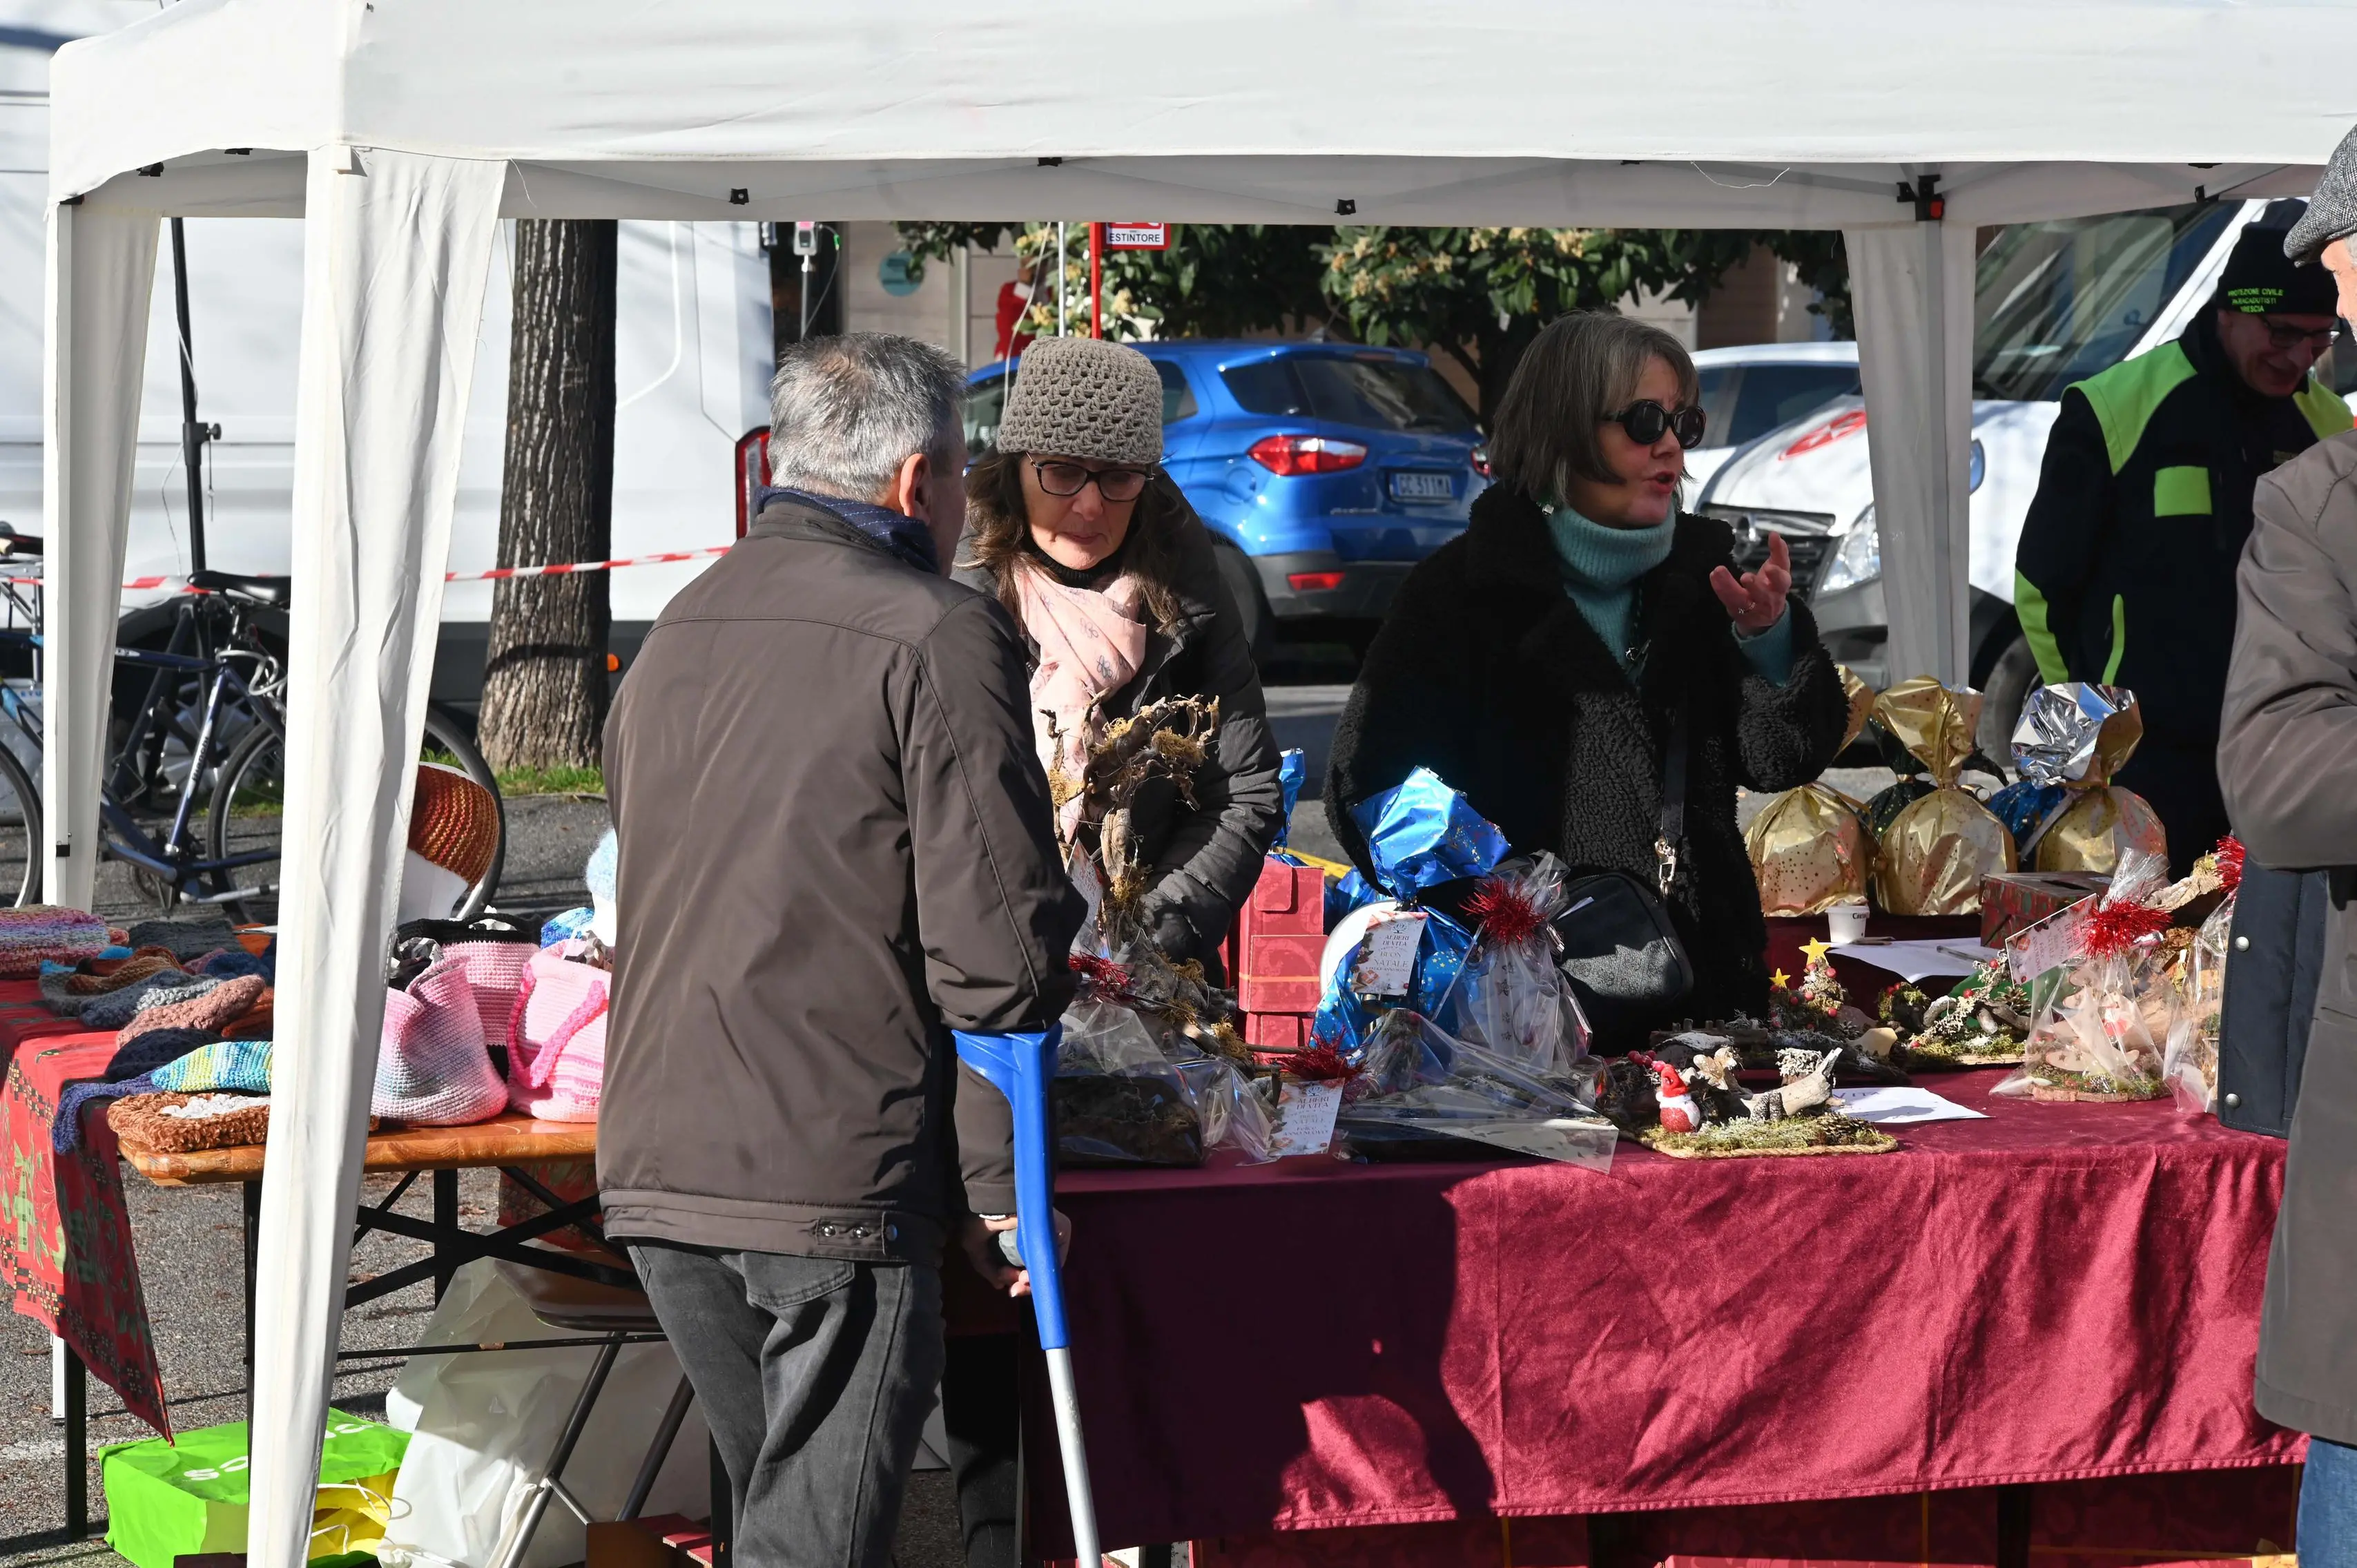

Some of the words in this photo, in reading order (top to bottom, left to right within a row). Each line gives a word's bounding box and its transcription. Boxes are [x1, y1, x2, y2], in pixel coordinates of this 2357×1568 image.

[1109, 233, 1161, 242] ESTINTORE
[2262, 288, 2284, 296] CIVILE
[1374, 958, 1409, 967] NATALE
